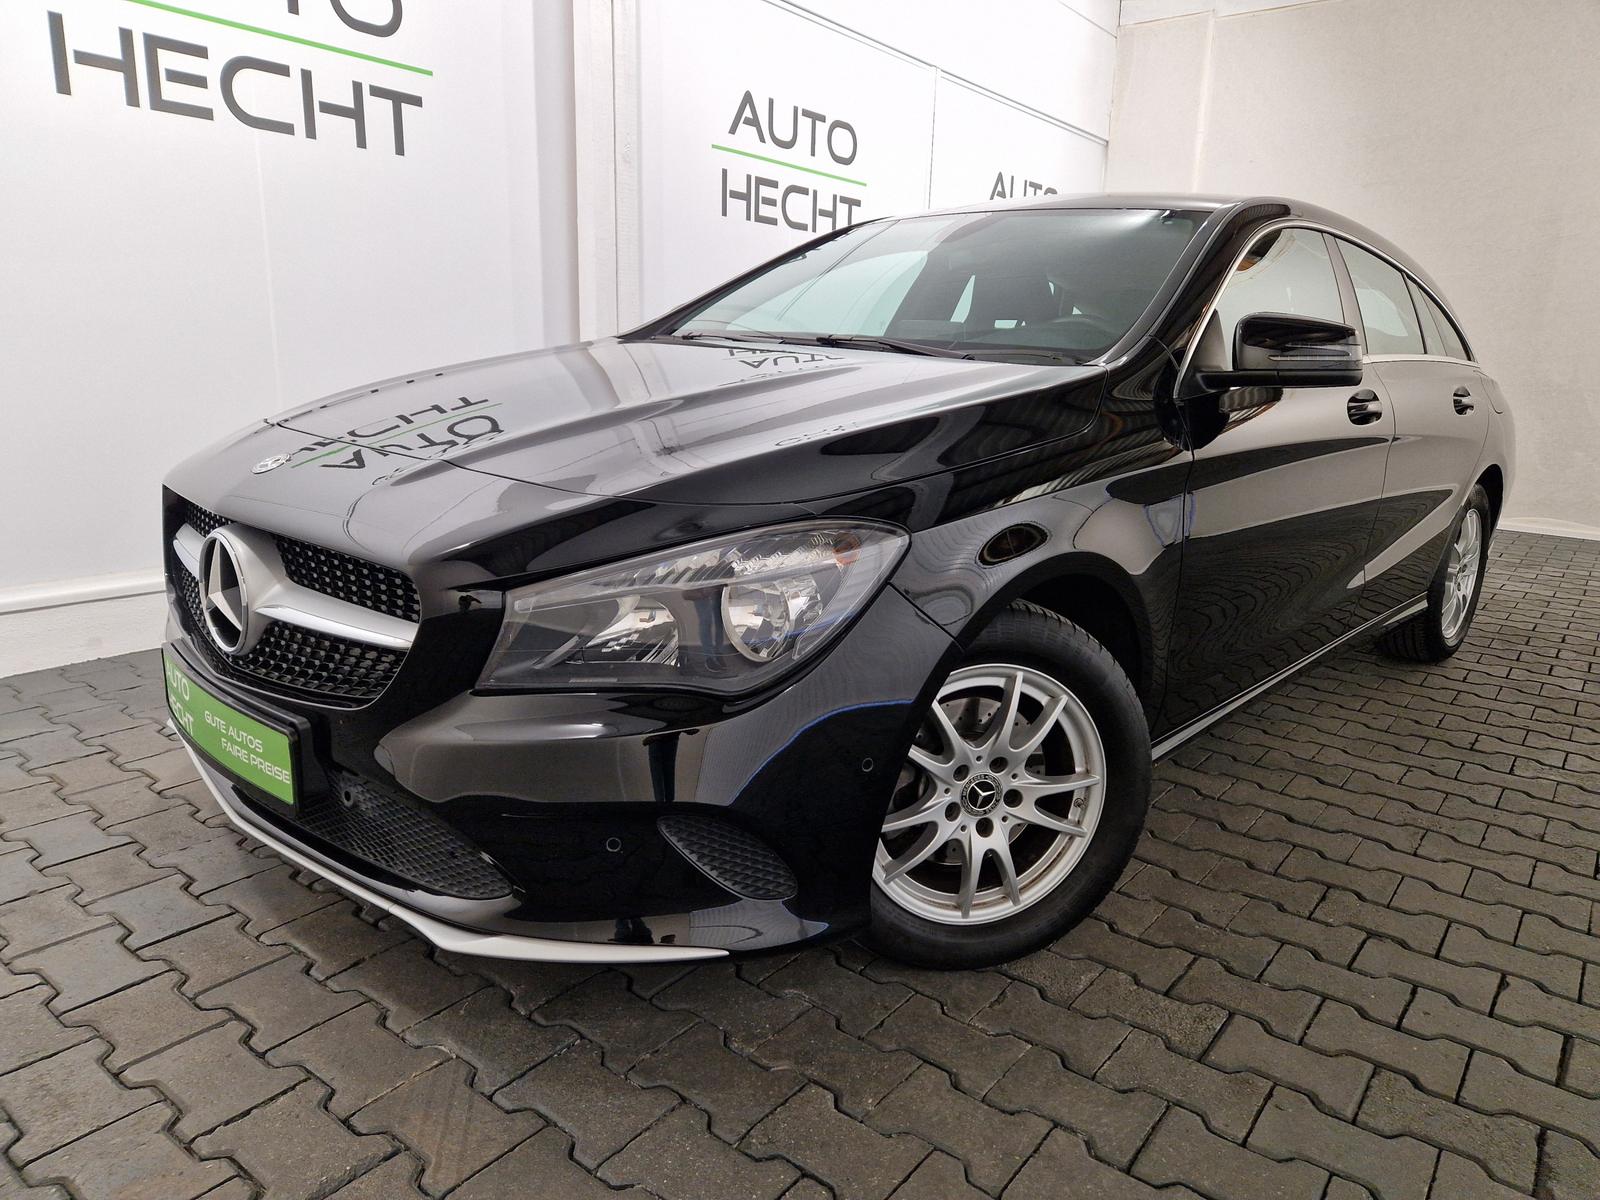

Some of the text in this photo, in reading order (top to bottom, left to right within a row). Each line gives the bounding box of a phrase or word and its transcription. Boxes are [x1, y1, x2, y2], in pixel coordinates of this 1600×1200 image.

[47, 10, 423, 156] HECHT
[728, 90, 858, 166] AUTO
[721, 168, 862, 233] HECHT
[204, 710, 263, 753] GUTE AUTOS
[221, 738, 291, 784] FAIRE PREISE
